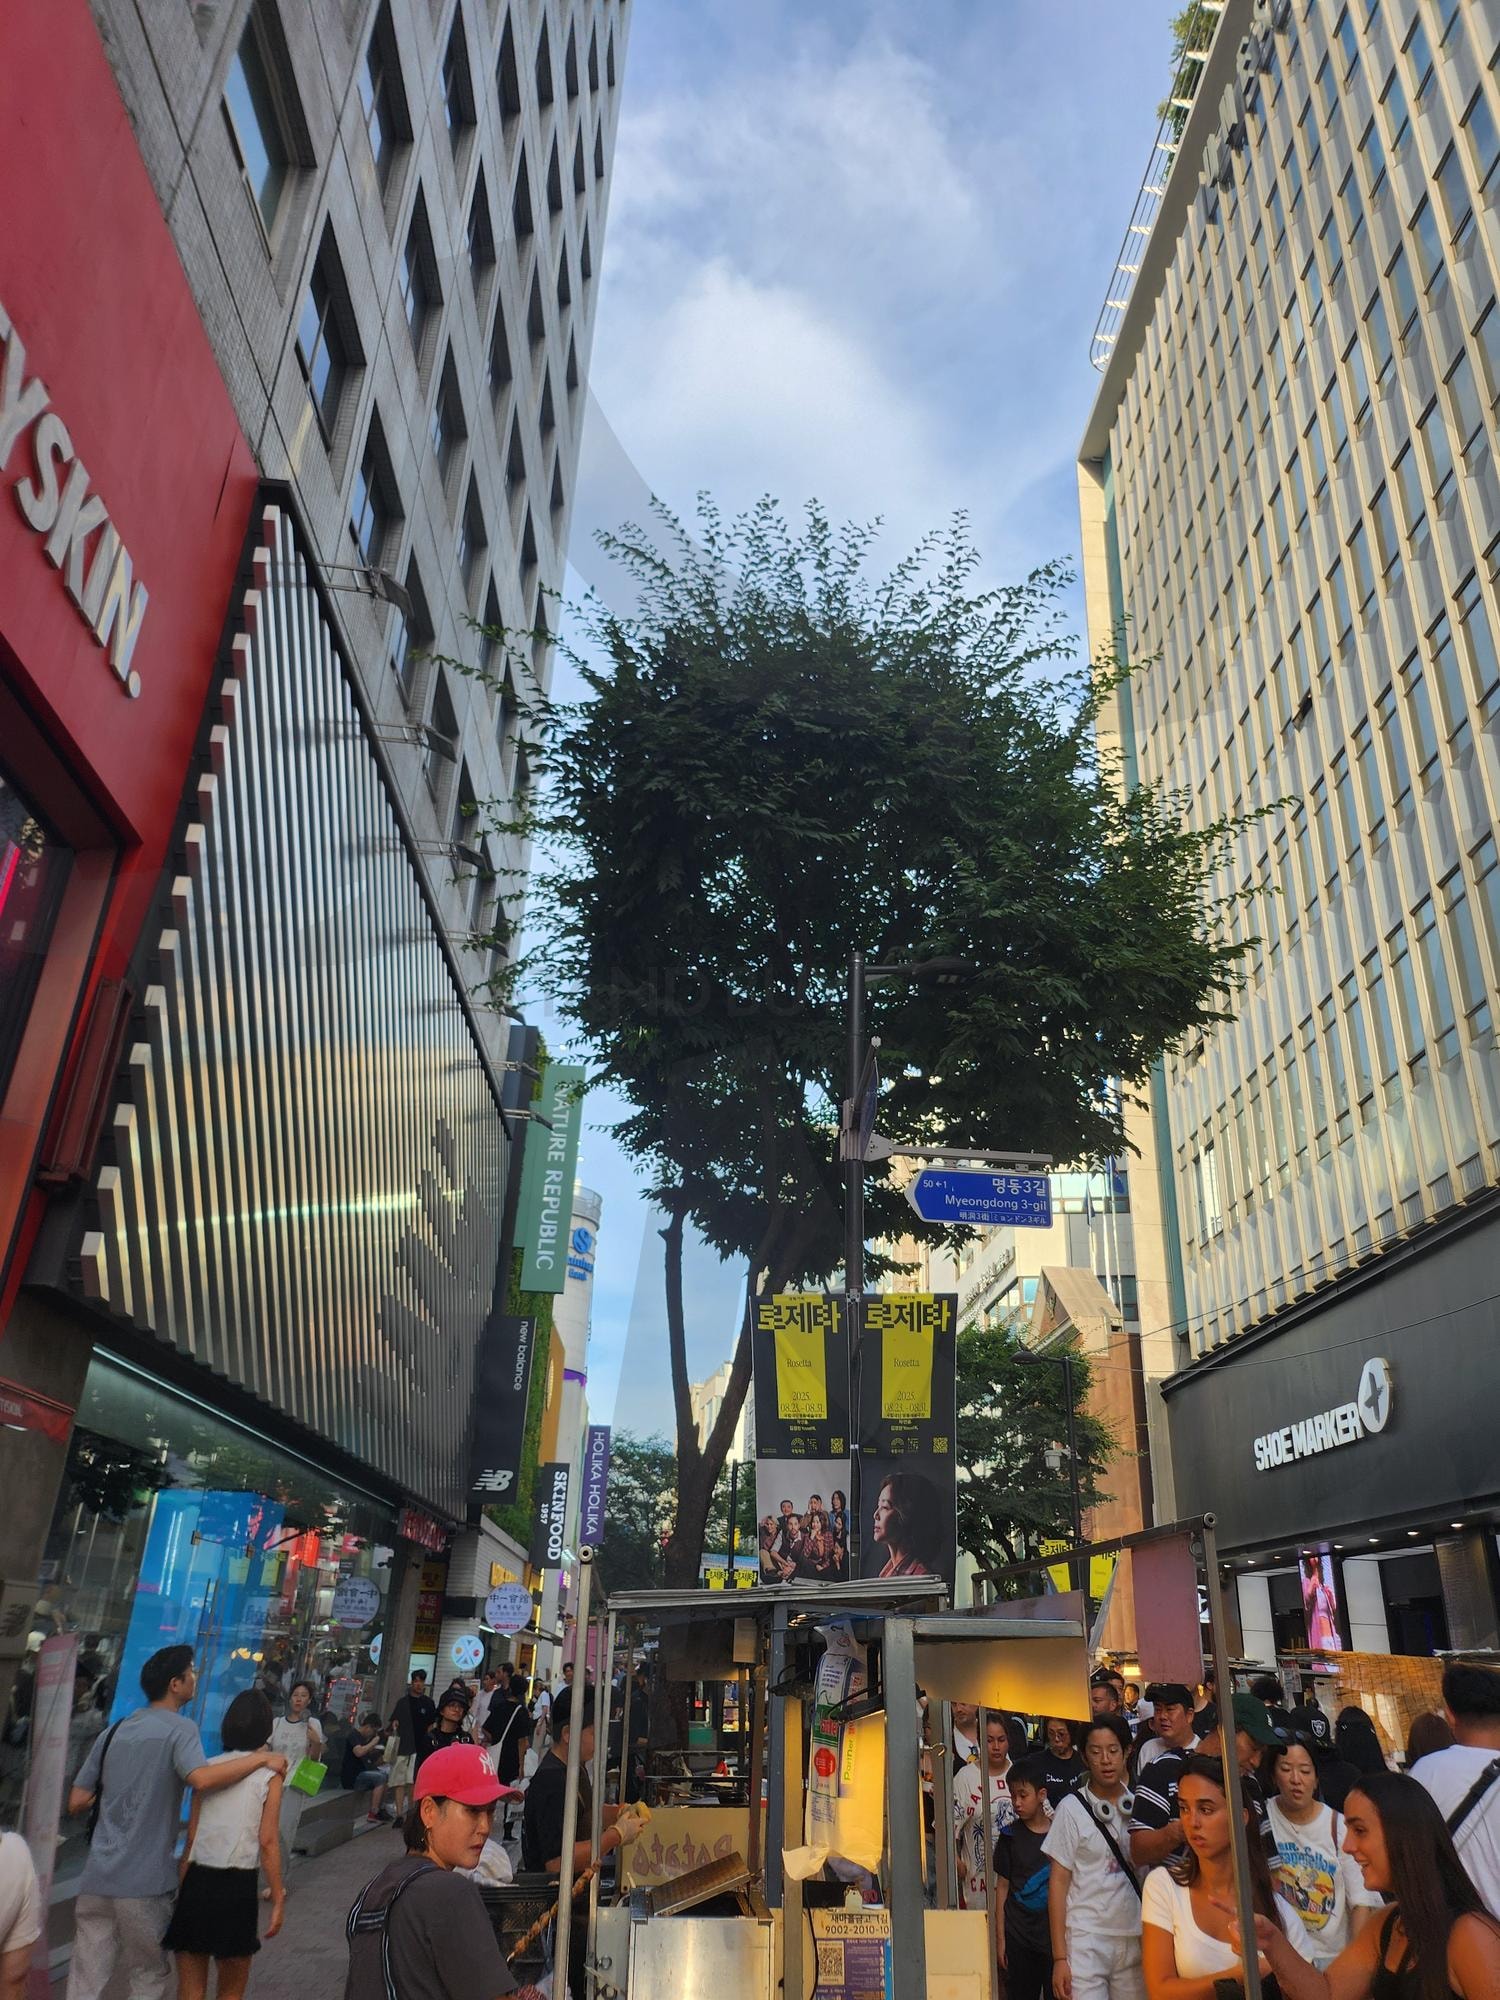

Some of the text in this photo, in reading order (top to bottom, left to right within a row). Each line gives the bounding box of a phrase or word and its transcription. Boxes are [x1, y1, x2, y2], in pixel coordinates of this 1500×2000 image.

[0, 302, 149, 699] YSKIN.
[536, 1085, 571, 1270] NATURE REPUBLIC
[923, 1179, 934, 1188] 50
[992, 1178, 1047, 1197] 명동3길
[945, 1194, 1047, 1212] Myeongdong 3-gil
[757, 1300, 841, 1333] 로제타
[864, 1299, 951, 1332] 로제타
[513, 1320, 530, 1391] new balance
[893, 1357, 920, 1367] Rosetta
[1253, 1401, 1366, 1472] SHOEMARKER
[585, 1431, 605, 1535] HOLIKA HOLIKA
[539, 1503, 549, 1525] 1957
[547, 1470, 568, 1560] SKINFOOD
[825, 1925, 890, 1935] 9002-2010-10
